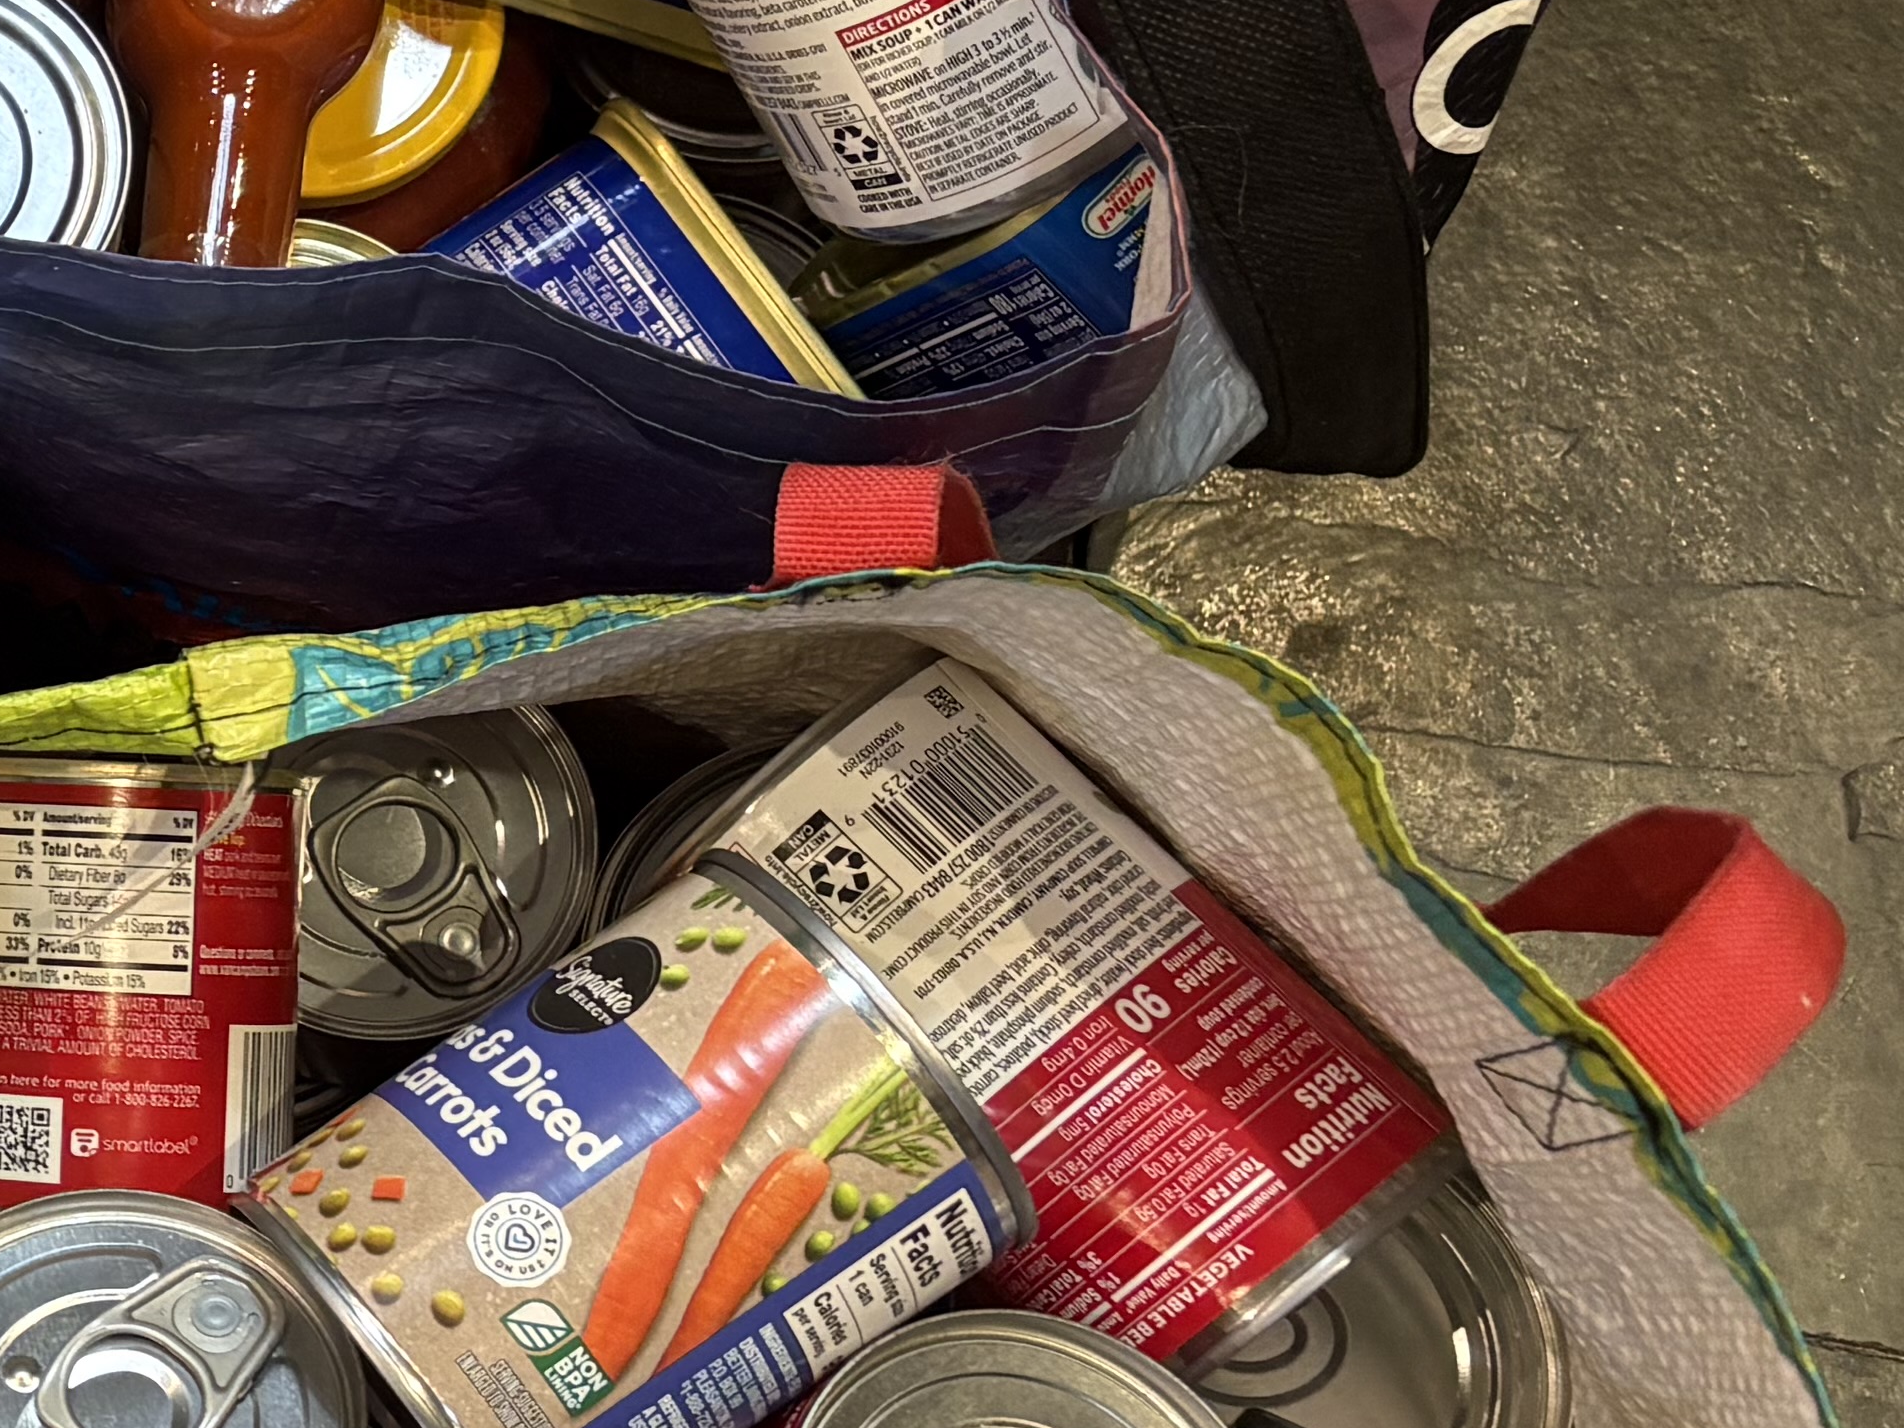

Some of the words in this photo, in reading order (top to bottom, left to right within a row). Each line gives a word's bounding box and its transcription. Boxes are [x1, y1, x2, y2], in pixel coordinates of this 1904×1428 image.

[548, 186, 581, 224] Facts
[564, 176, 614, 236] Nutrition
[859, 741, 905, 780] 1231-22N
[789, 823, 815, 849] CAN
[792, 830, 832, 862] METAL
[555, 955, 633, 1015] Signature
[1174, 945, 1239, 995] Calories
[1114, 983, 1173, 1034] 90
[468, 1028, 515, 1064] &
[395, 1054, 509, 1156] Carrots
[1294, 1056, 1364, 1110] Facts
[489, 1046, 625, 1173] Diced
[1282, 1082, 1393, 1169] Nutrition
[899, 1224, 942, 1288] Facts
[1151, 1243, 1255, 1335] VEGETABLE
[814, 1291, 848, 1346] Calories
[556, 1357, 592, 1405] BPA
[569, 1345, 609, 1394] NON
